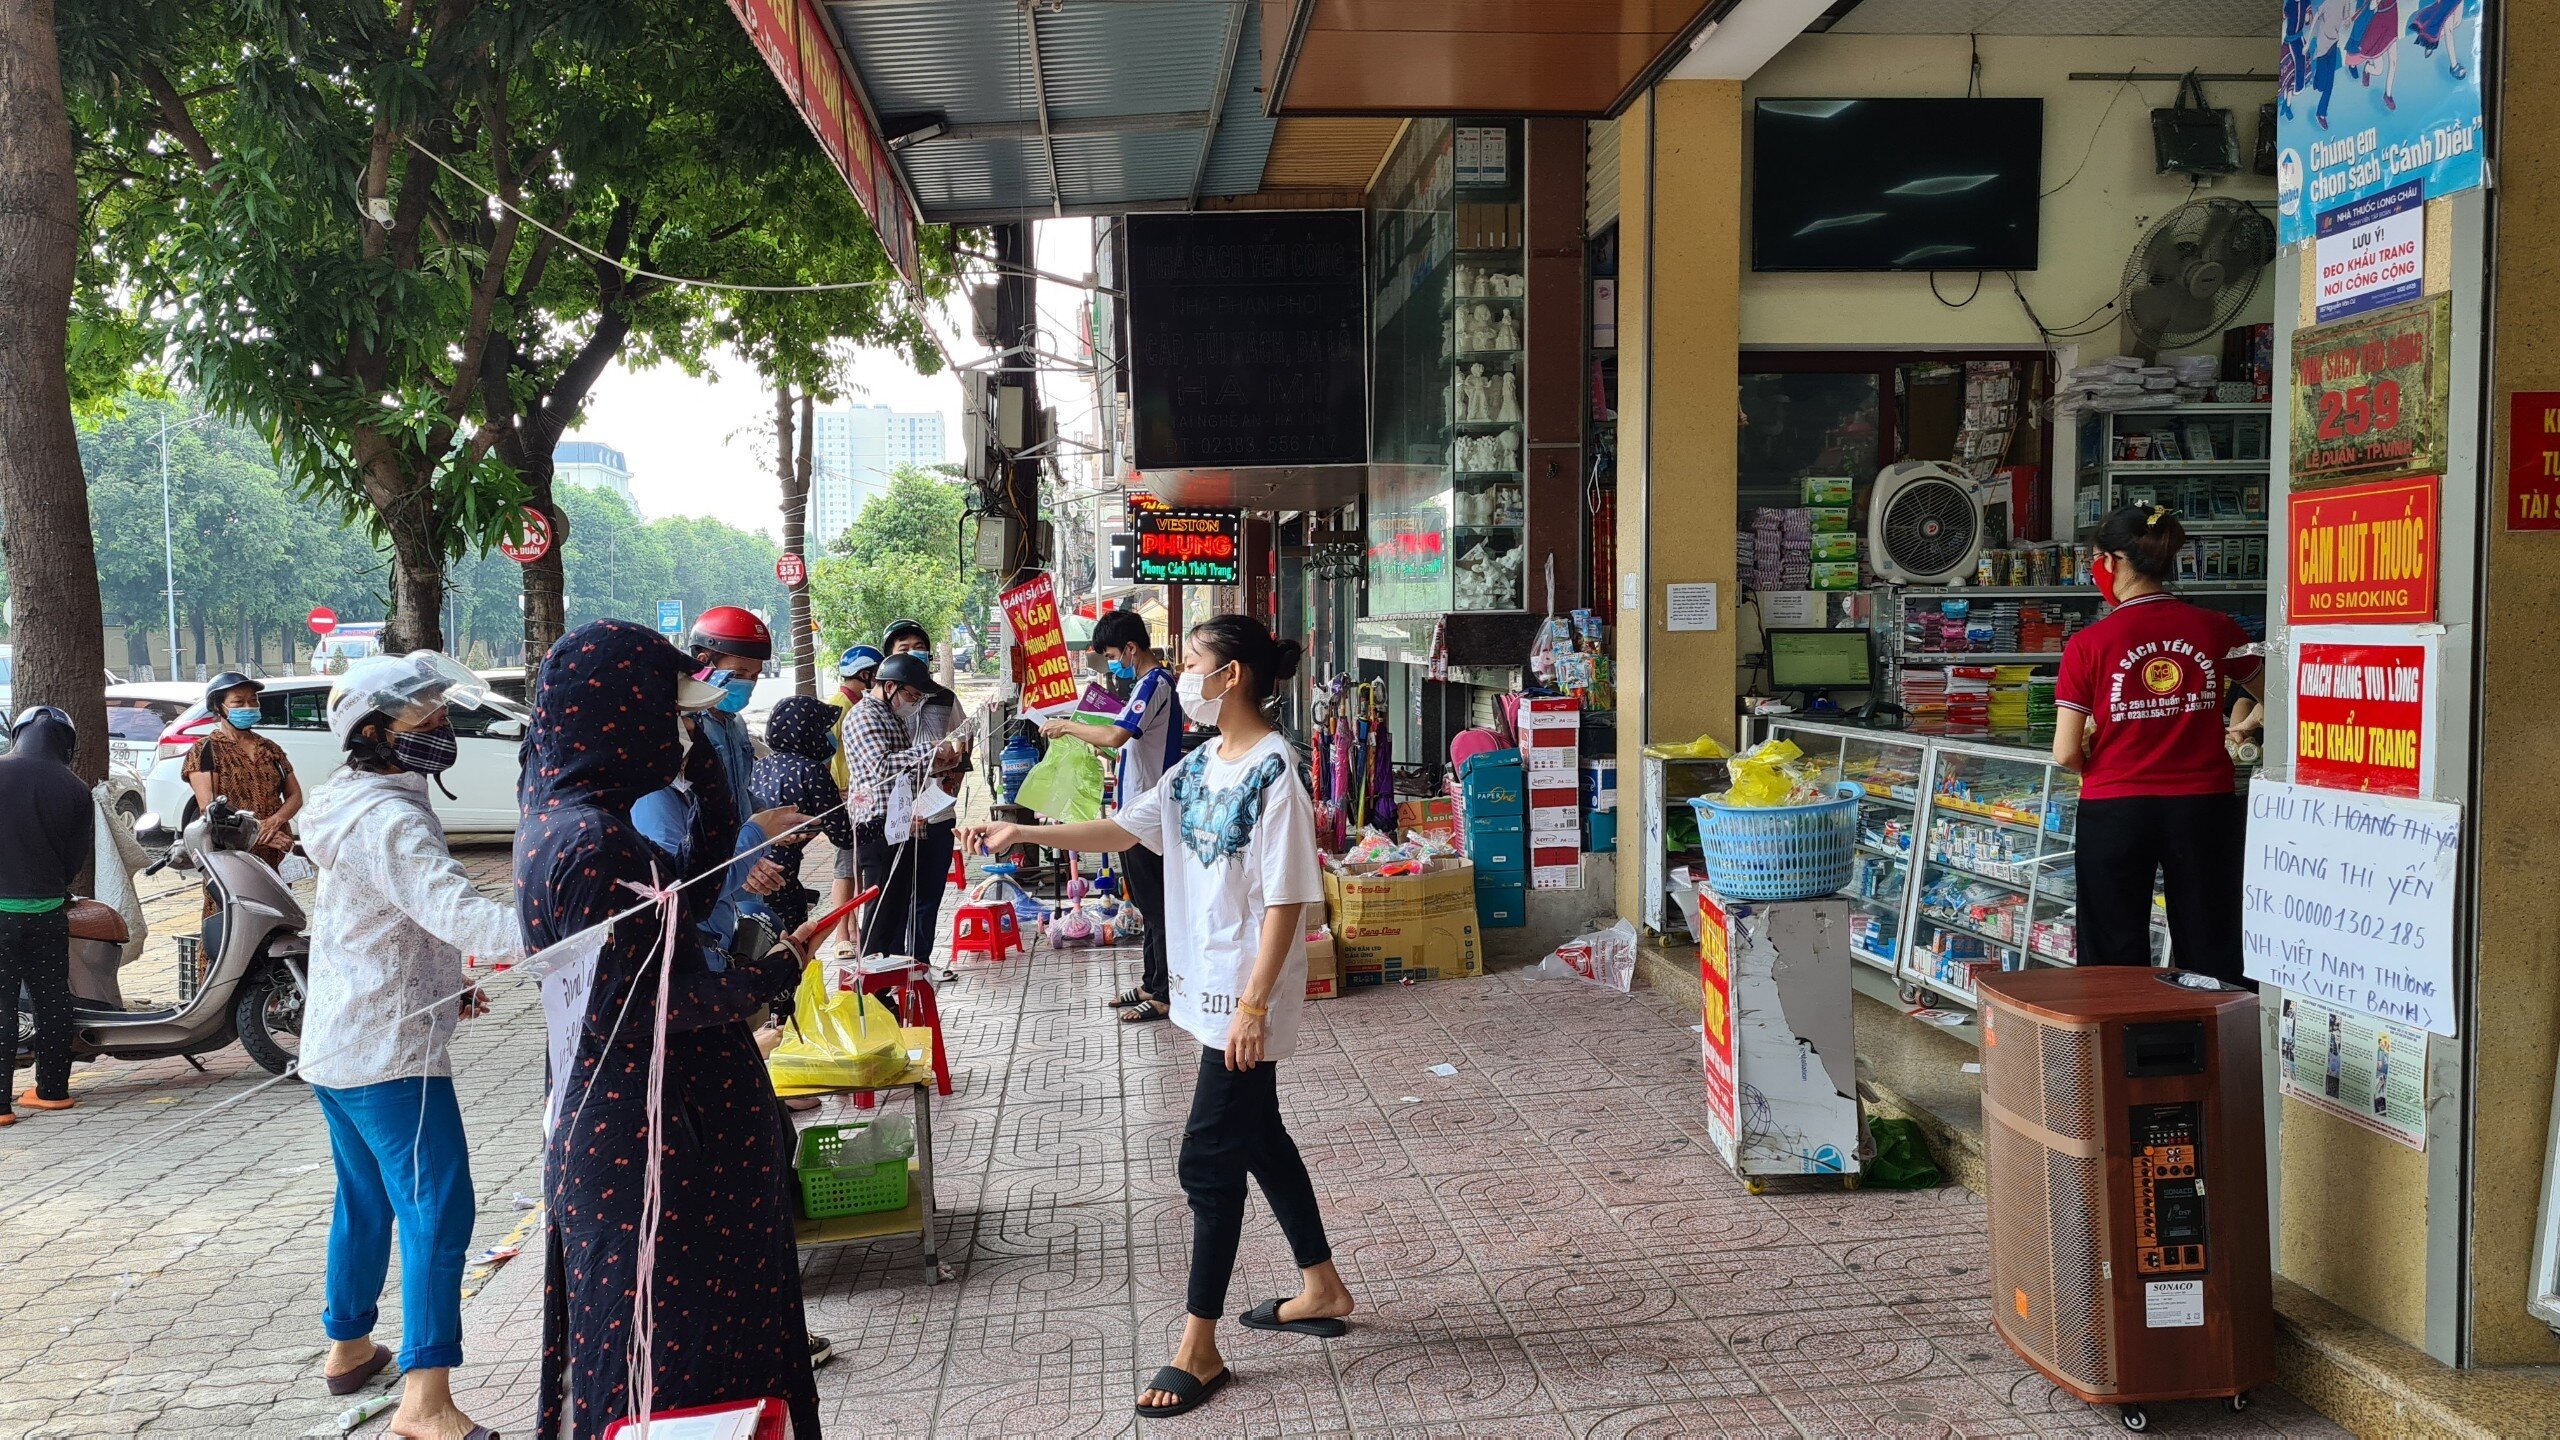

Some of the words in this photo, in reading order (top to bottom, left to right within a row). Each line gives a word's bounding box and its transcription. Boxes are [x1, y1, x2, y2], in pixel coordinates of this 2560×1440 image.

[2310, 136, 2355, 172] Chúng
[2357, 127, 2377, 152] em
[2310, 168, 2346, 203] chọn
[2348, 158, 2381, 191] sách
[2337, 207, 2351, 222] NHÀ
[2353, 199, 2376, 217] THUỐC
[2377, 195, 2397, 208] LONG
[2398, 187, 2418, 202] CHÂU
[2352, 229, 2371, 250] LƯU
[2375, 225, 2385, 243] Ý!
[2323, 262, 2344, 279] ĐEO
[2348, 247, 2376, 272] KHẨU
[2379, 241, 2415, 261] TRANG
[2324, 280, 2343, 297] NƠI
[2346, 270, 2378, 290] CÔNG
[2381, 261, 2415, 282] CỘNG
[2317, 378, 2400, 441] 259
[2520, 488, 2549, 519] TÀI
[1155, 518, 1220, 532] VESTON
[2299, 506, 2334, 586] CẤM
[2337, 510, 2367, 582] HÚT
[2372, 495, 2424, 581] THUỐC
[1142, 533, 1234, 560] PHỤNG
[779, 564, 802, 576] 251
[1141, 560, 1166, 578] Phong
[1167, 561, 1187, 576] Cách
[1188, 560, 1207, 576] Thời
[1208, 562, 1233, 579] Trang
[2310, 593, 2332, 609] NO
[2336, 589, 2408, 608] SMOKING
[2110, 672, 2125, 703] NHÀ
[2120, 641, 2158, 670] SÁCH
[2162, 638, 2194, 656] YẾN
[2193, 651, 2217, 689] CÔNG
[2300, 657, 2332, 697] KHÁCH
[2334, 658, 2361, 701] HÀNG
[2365, 665, 2385, 701] VUI
[2388, 658, 2419, 703] LÒNG
[2129, 699, 2145, 710] 259
[2300, 720, 2324, 759] ĐEO
[2327, 710, 2365, 764] KHẨU
[2368, 726, 2416, 769] TRANG
[2253, 787, 2294, 820] CHỦ
[2264, 841, 2328, 881] HOÀNG
[2340, 862, 2377, 894] THỊ
[2270, 963, 2296, 987] TÍN
[2321, 951, 2365, 981] NAM
[2153, 1282, 2193, 1292] SONACO
